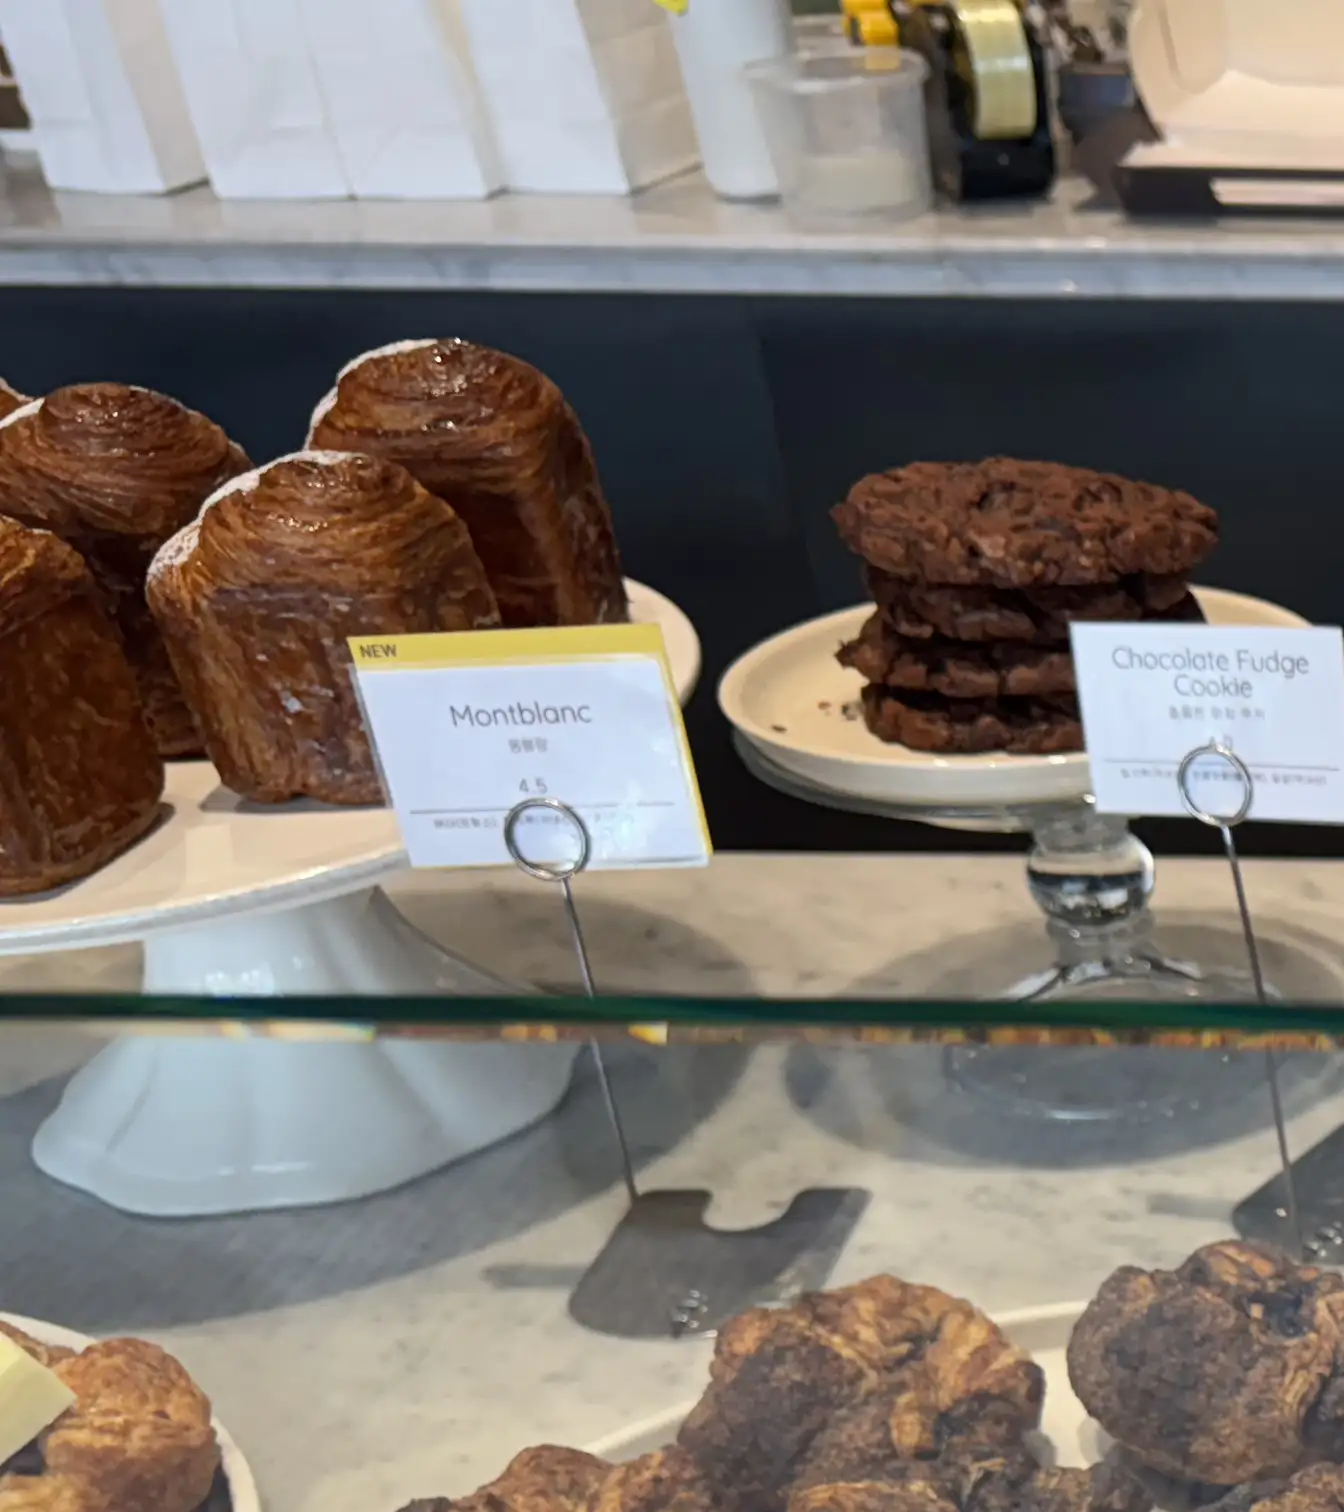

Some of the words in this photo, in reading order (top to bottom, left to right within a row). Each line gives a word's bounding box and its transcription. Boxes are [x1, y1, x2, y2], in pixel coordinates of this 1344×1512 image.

[359, 644, 397, 658] NEW
[1111, 646, 1229, 671] Chocolate
[1236, 649, 1310, 679] Fudge
[1174, 674, 1253, 698] Cookie
[450, 700, 593, 727] Montblanc
[519, 778, 548, 794] 4.5
